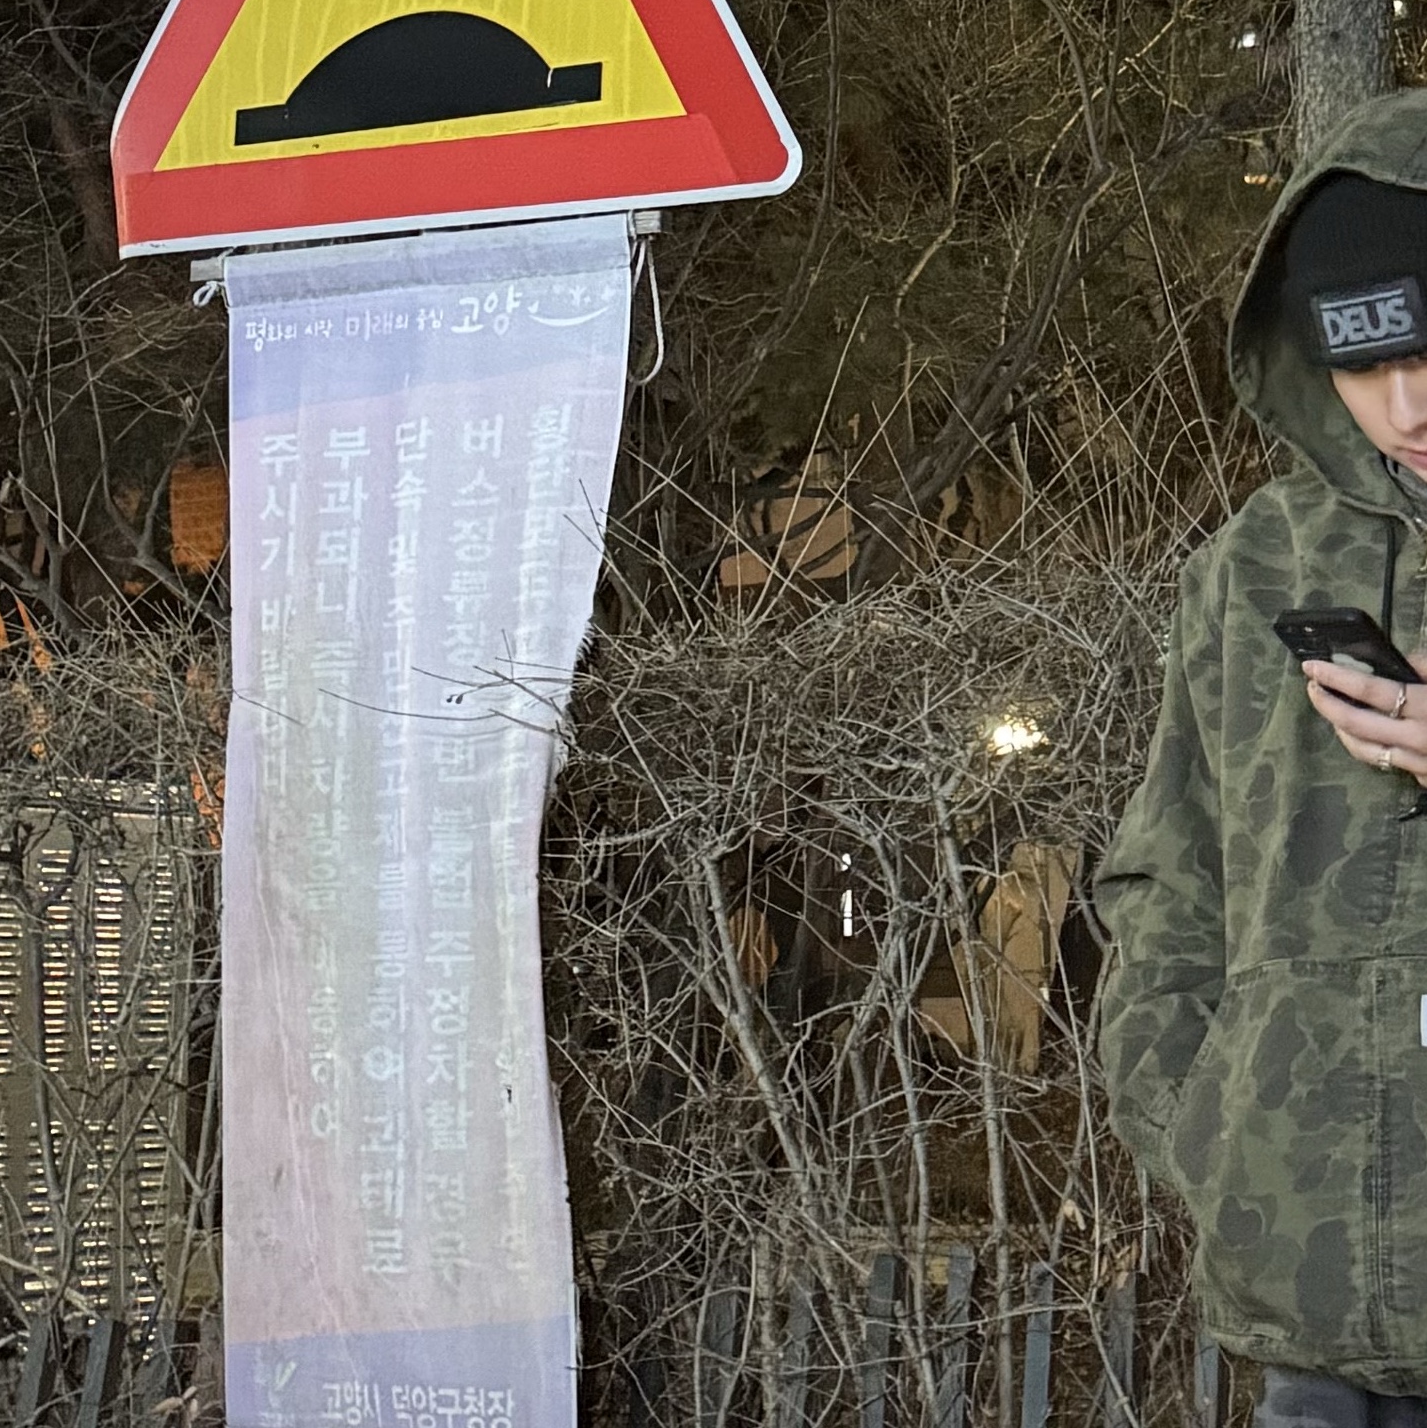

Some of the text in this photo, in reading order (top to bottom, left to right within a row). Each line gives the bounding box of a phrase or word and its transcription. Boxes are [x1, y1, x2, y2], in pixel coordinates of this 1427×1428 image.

[450, 284, 522, 337] 고양
[1322, 296, 1414, 347] DEUS
[389, 414, 435, 514] 단속
[257, 430, 302, 577] 주시기
[314, 424, 371, 623] 부과되니
[322, 1380, 382, 1428] 고양시
